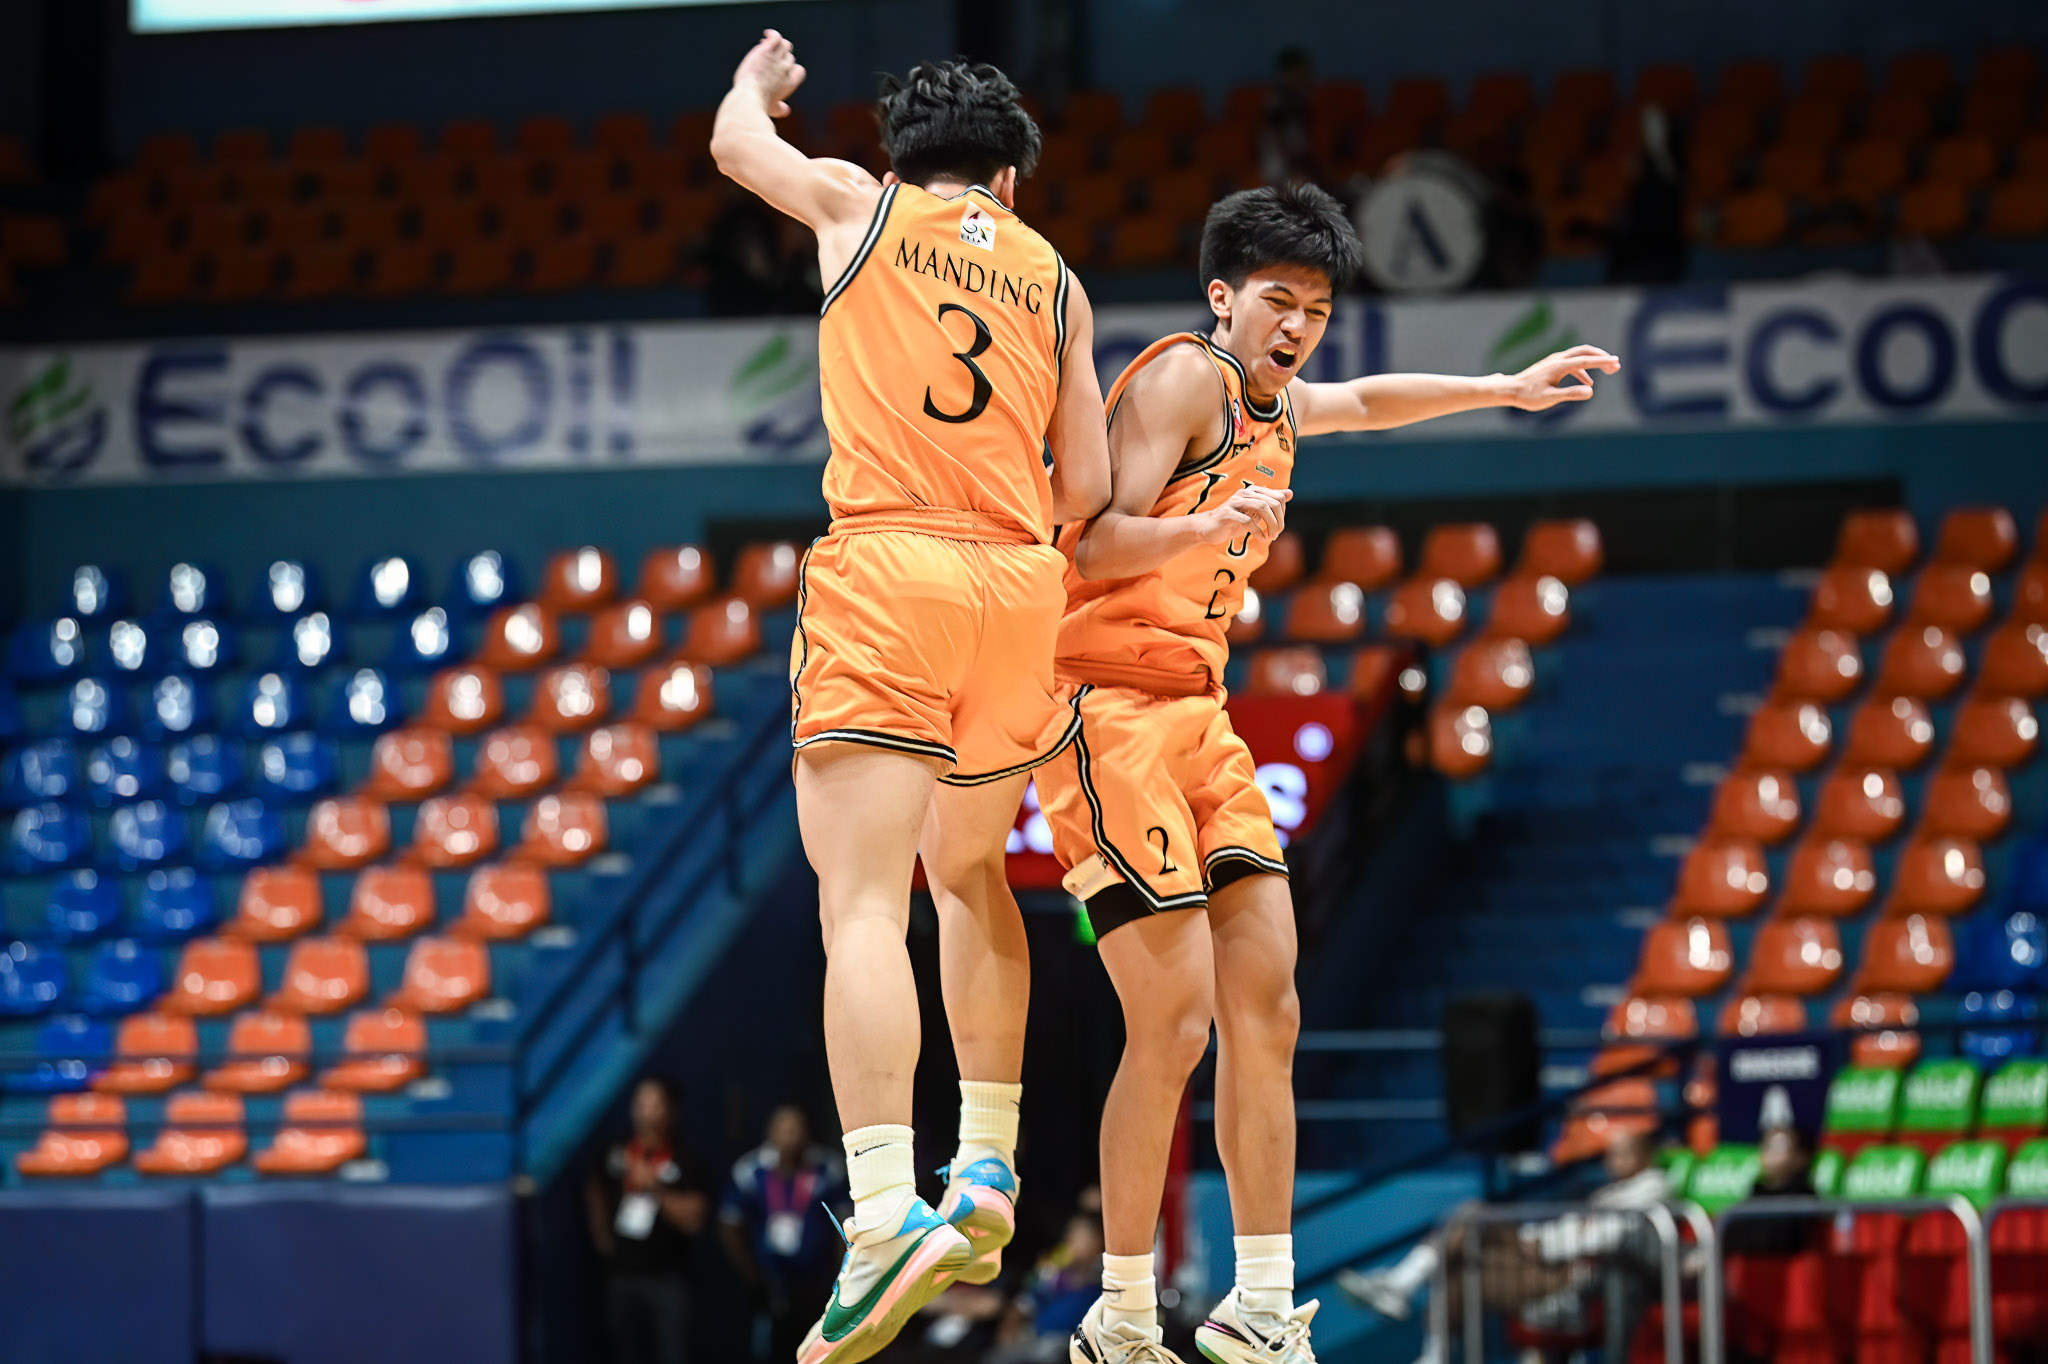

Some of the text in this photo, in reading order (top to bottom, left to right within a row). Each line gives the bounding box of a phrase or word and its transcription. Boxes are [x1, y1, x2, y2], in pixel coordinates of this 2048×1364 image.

[895, 237, 1042, 315] MANDING
[923, 303, 993, 424] 3
[1204, 568, 1236, 620] 2
[1146, 825, 1179, 876] 2
